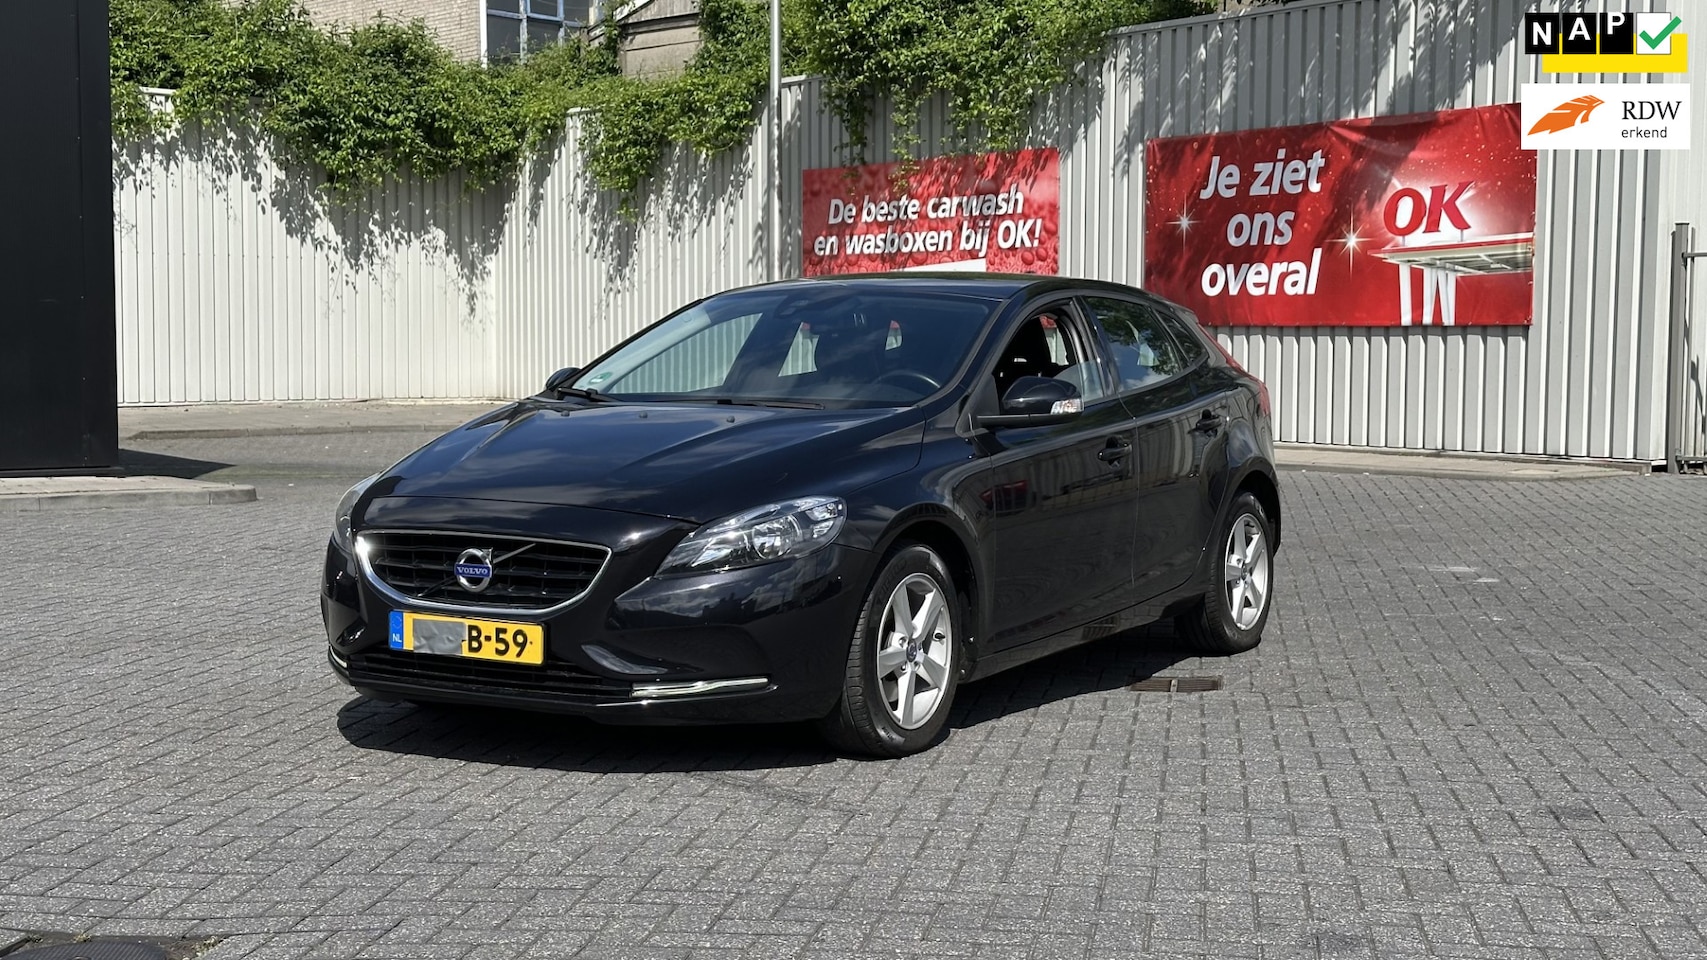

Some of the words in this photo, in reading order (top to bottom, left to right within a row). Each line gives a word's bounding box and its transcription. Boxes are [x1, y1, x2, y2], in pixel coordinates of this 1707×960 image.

[1200, 155, 1240, 199] Je
[1249, 148, 1326, 196] ziet
[828, 198, 857, 224] De
[861, 195, 920, 223] beste
[926, 183, 1025, 219] carwash
[1383, 180, 1476, 237] OK
[813, 234, 839, 257] en
[845, 226, 953, 255] wasboxen
[959, 218, 991, 258] bij
[996, 217, 1043, 249] OK!
[1226, 209, 1295, 248] ons
[1200, 247, 1323, 298] overal
[456, 566, 489, 576] VOLVO
[392, 633, 402, 643] NL
[461, 624, 528, 658] B-59
